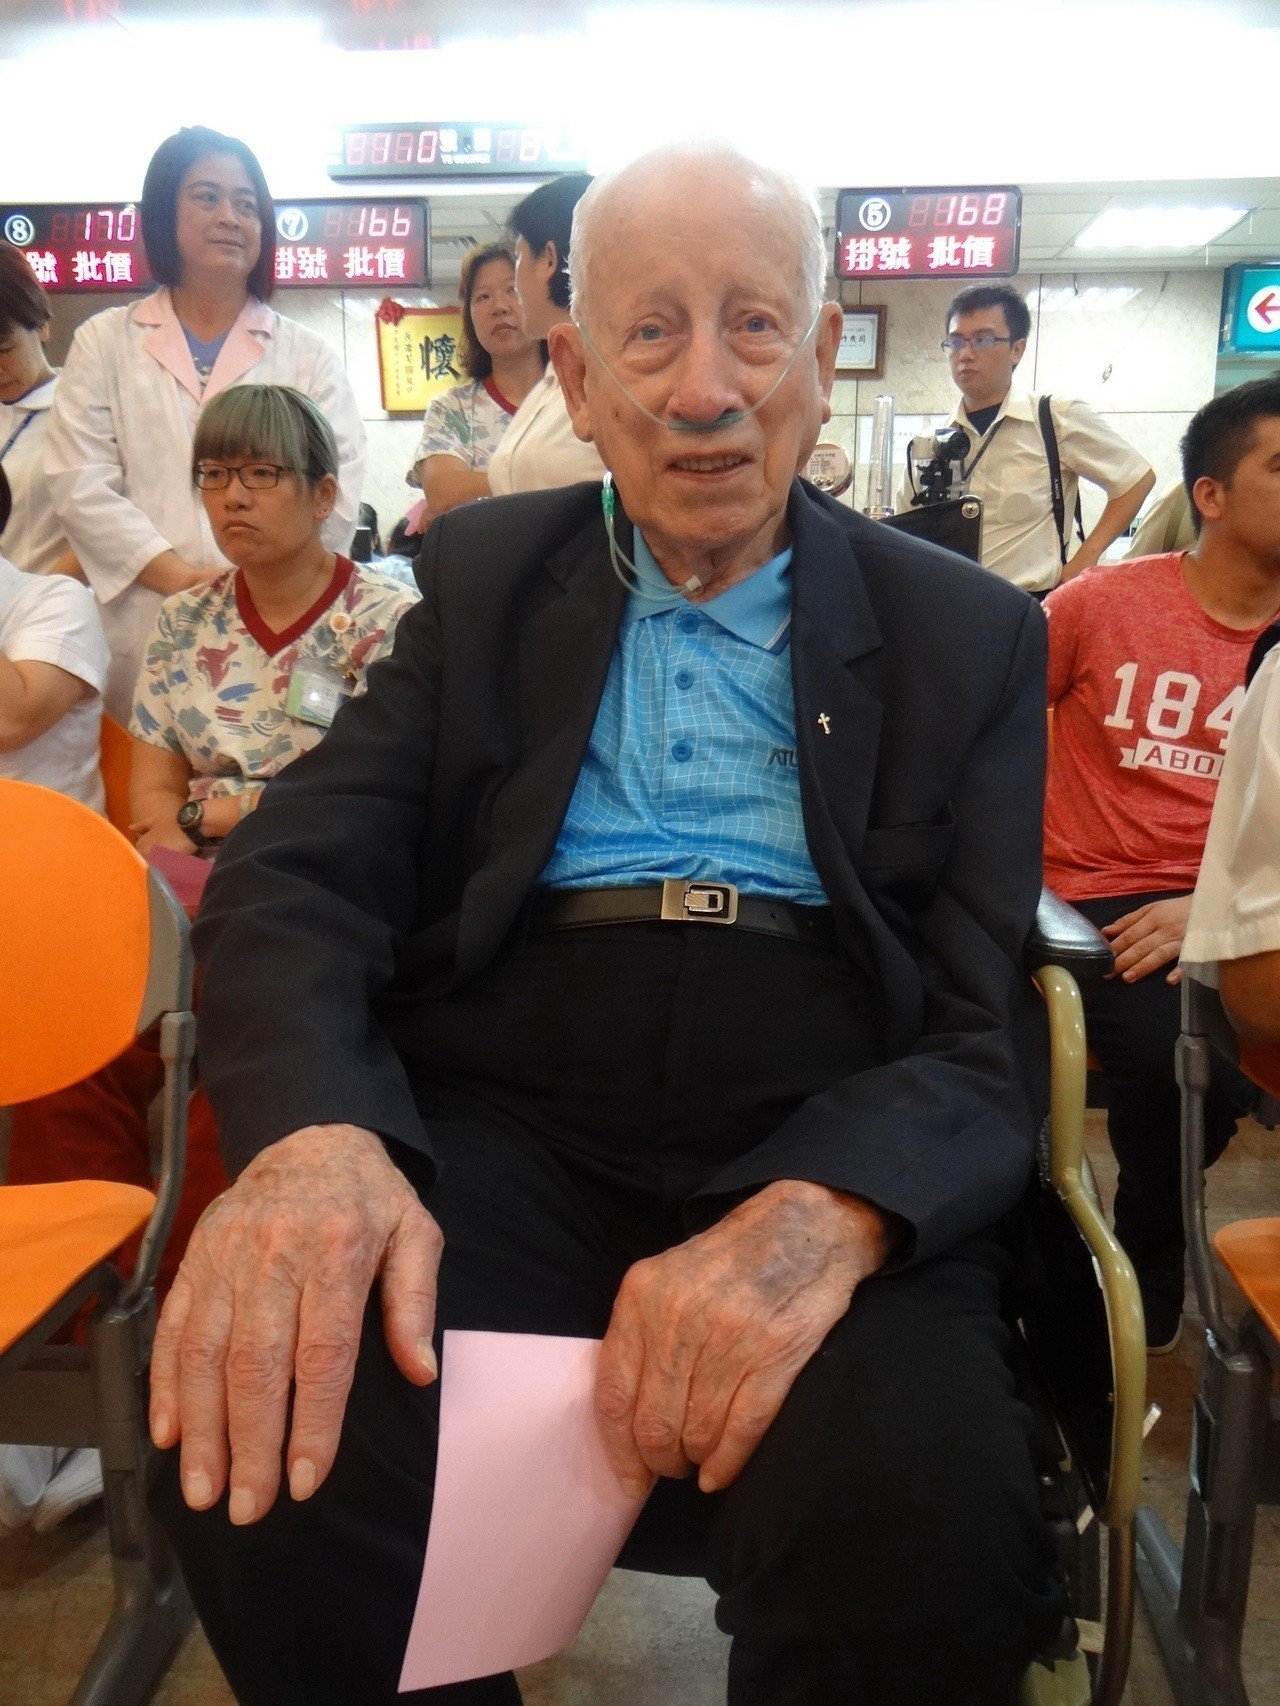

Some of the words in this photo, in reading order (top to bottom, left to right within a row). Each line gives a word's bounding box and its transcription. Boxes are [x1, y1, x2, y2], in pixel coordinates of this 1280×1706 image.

[84, 210, 136, 241] 170
[358, 206, 411, 237] 166
[946, 193, 1008, 226] 168
[71, 250, 133, 282] 批價
[342, 246, 406, 279] 批價
[927, 235, 996, 269] 批價
[419, 333, 462, 382] 懷
[1103, 661, 1247, 750] 184
[1143, 744, 1224, 778] ABO
